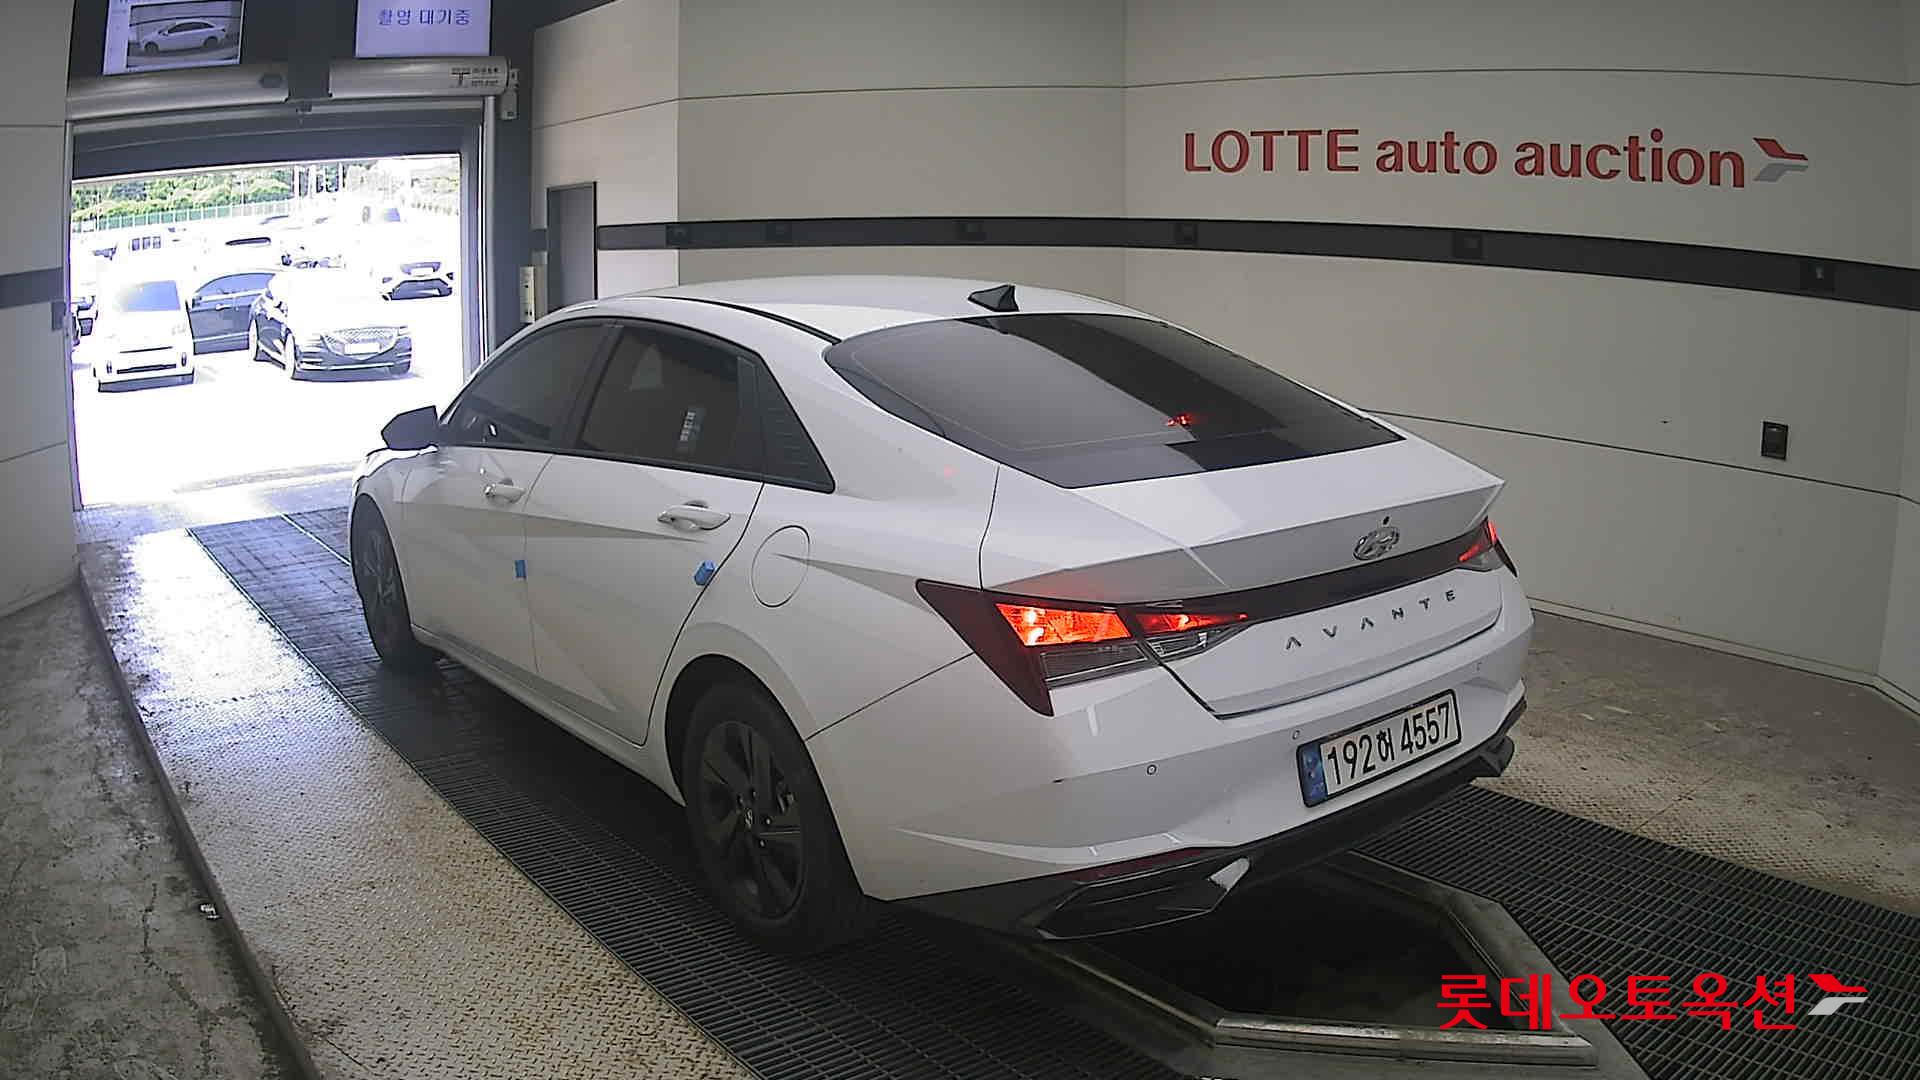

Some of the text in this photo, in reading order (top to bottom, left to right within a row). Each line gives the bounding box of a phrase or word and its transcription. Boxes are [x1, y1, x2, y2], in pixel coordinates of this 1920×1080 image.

[419, 9, 471, 25] 대기중
[1184, 128, 1746, 188] LOTTE auto auction
[1285, 589, 1457, 651] AVANTE
[1327, 702, 1450, 785] 192허 4557
